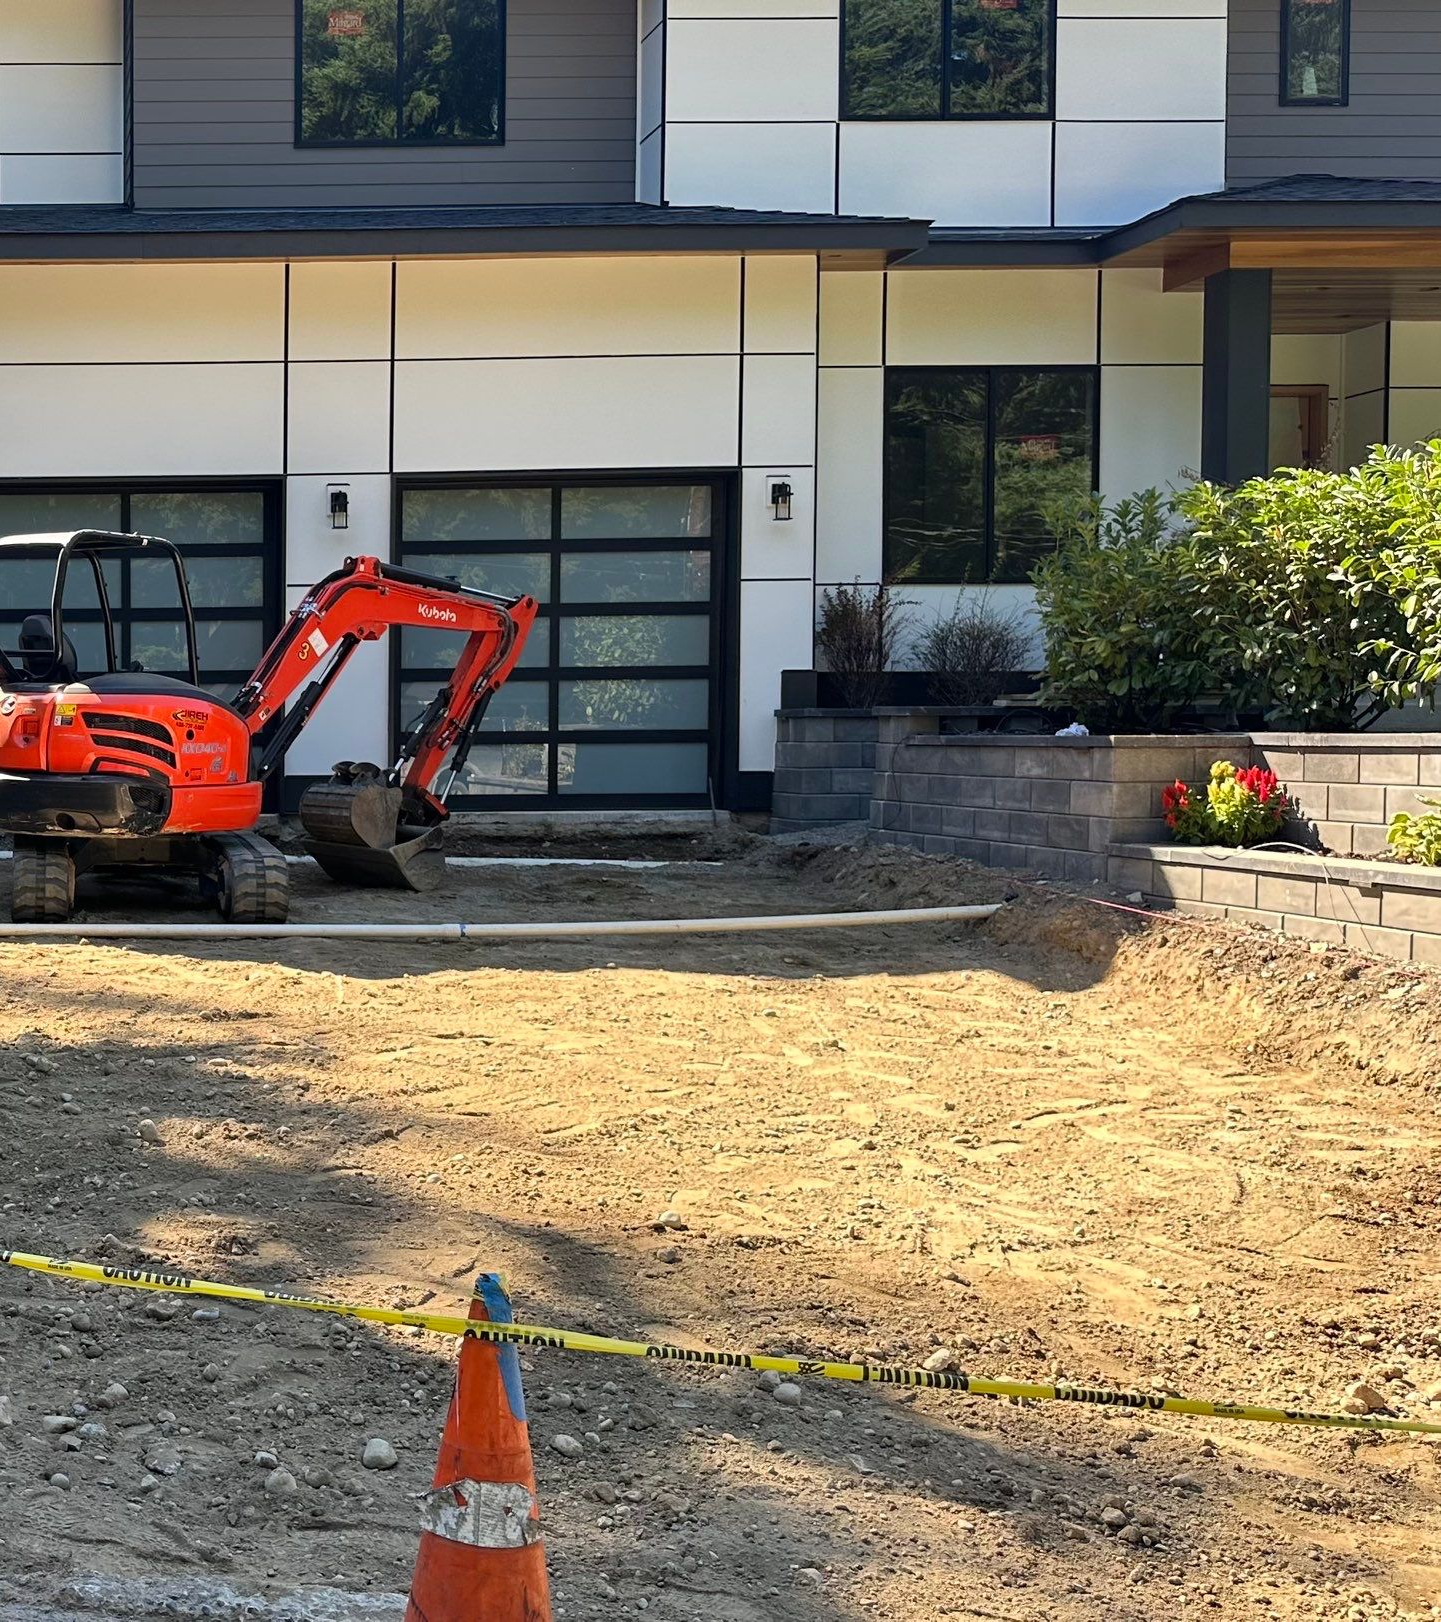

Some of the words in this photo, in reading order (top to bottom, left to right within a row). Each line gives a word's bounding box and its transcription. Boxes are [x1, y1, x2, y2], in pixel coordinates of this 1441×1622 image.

[418, 603, 457, 623] Kubota
[298, 641, 310, 661] 3
[102, 1266, 191, 1288] CAUTION
[463, 1328, 565, 1348] CAUTION
[645, 1345, 752, 1368] CUIDADO
